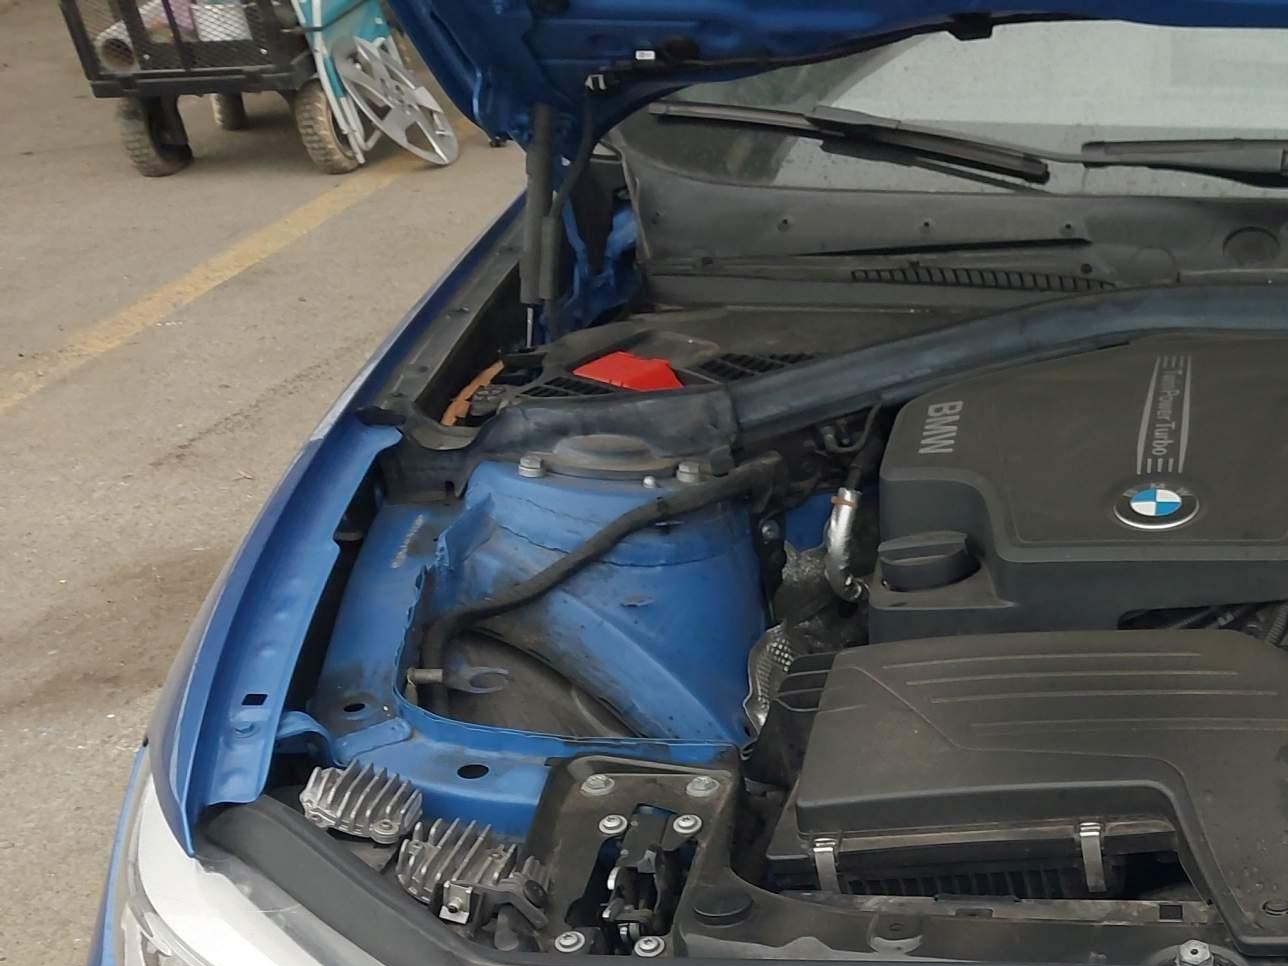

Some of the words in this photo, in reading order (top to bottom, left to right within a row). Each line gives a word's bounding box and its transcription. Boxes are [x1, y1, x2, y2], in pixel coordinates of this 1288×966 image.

[1157, 369, 1183, 420] TPower
[918, 400, 964, 454] BMW
[1151, 421, 1176, 456] Turbo
